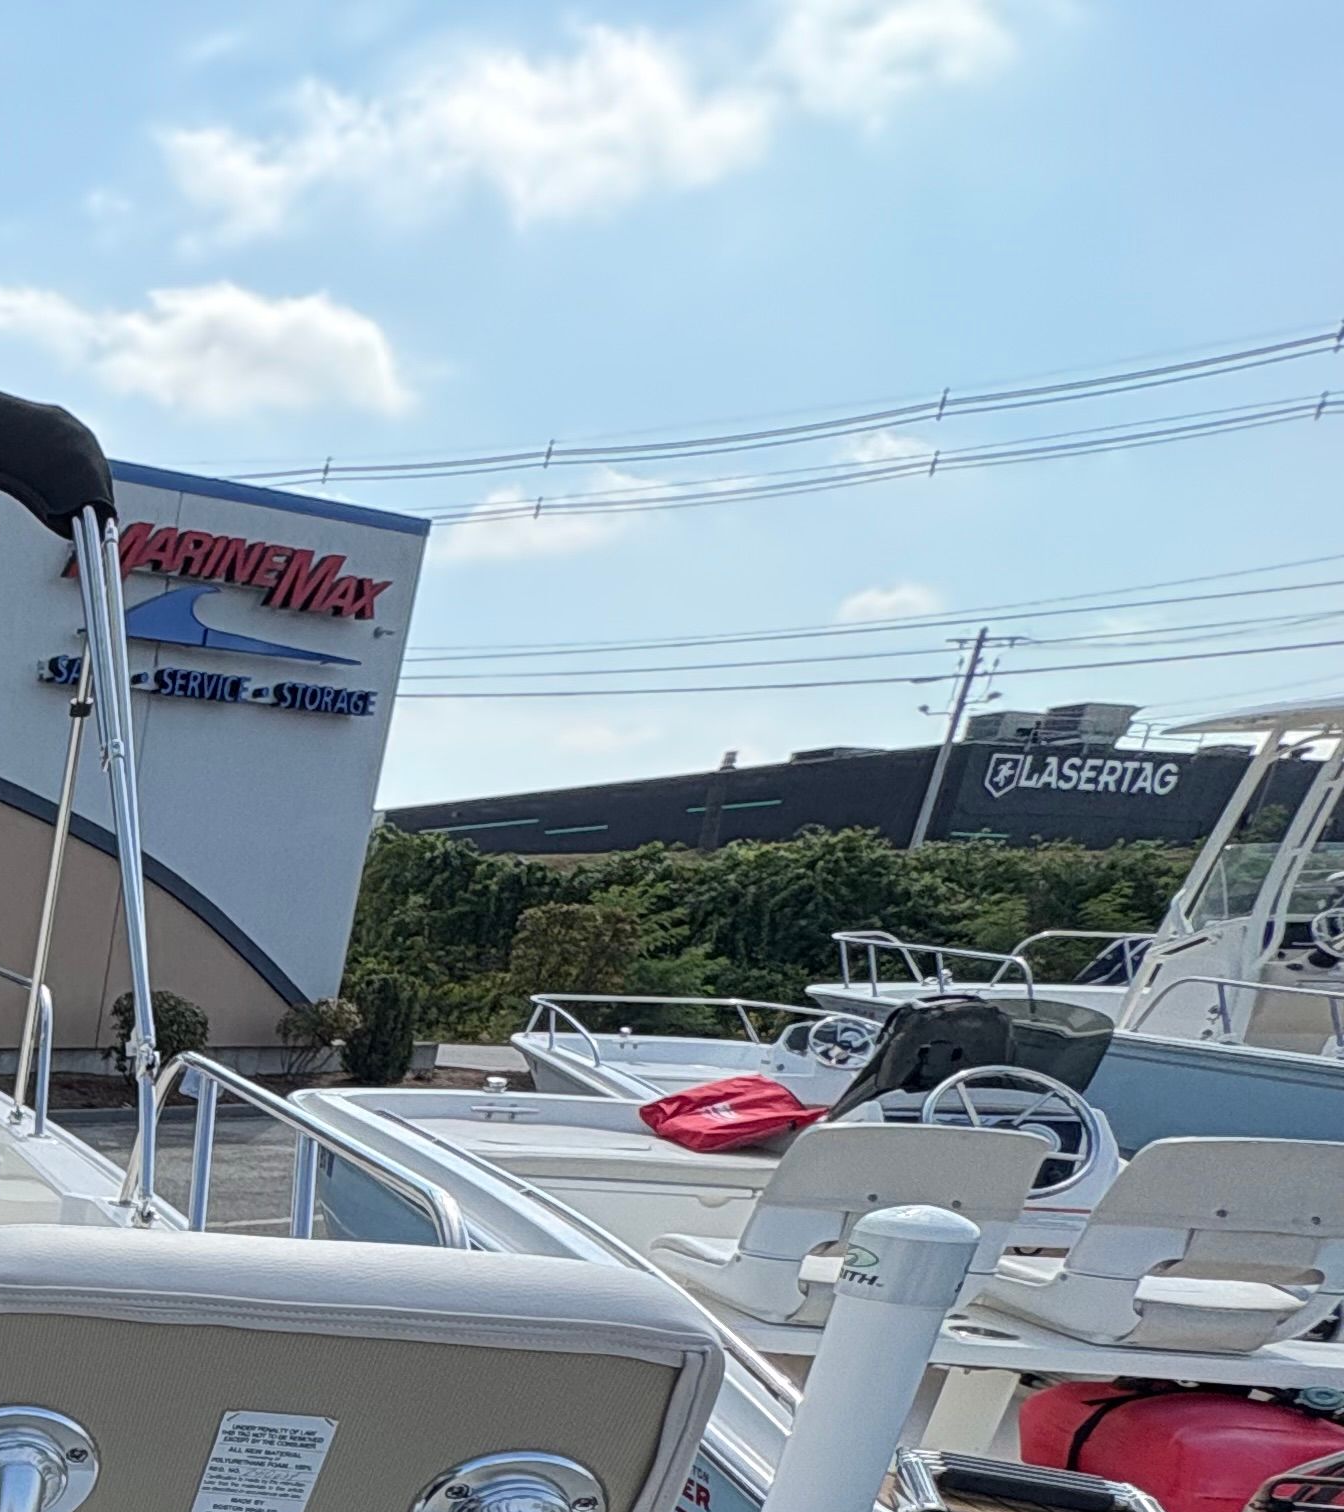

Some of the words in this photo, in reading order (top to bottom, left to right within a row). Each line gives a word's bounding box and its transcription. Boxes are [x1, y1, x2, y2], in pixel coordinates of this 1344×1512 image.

[158, 668, 253, 702] SERVICE
[279, 682, 378, 717] STORAGE
[1018, 755, 1180, 797] LASERTAG
